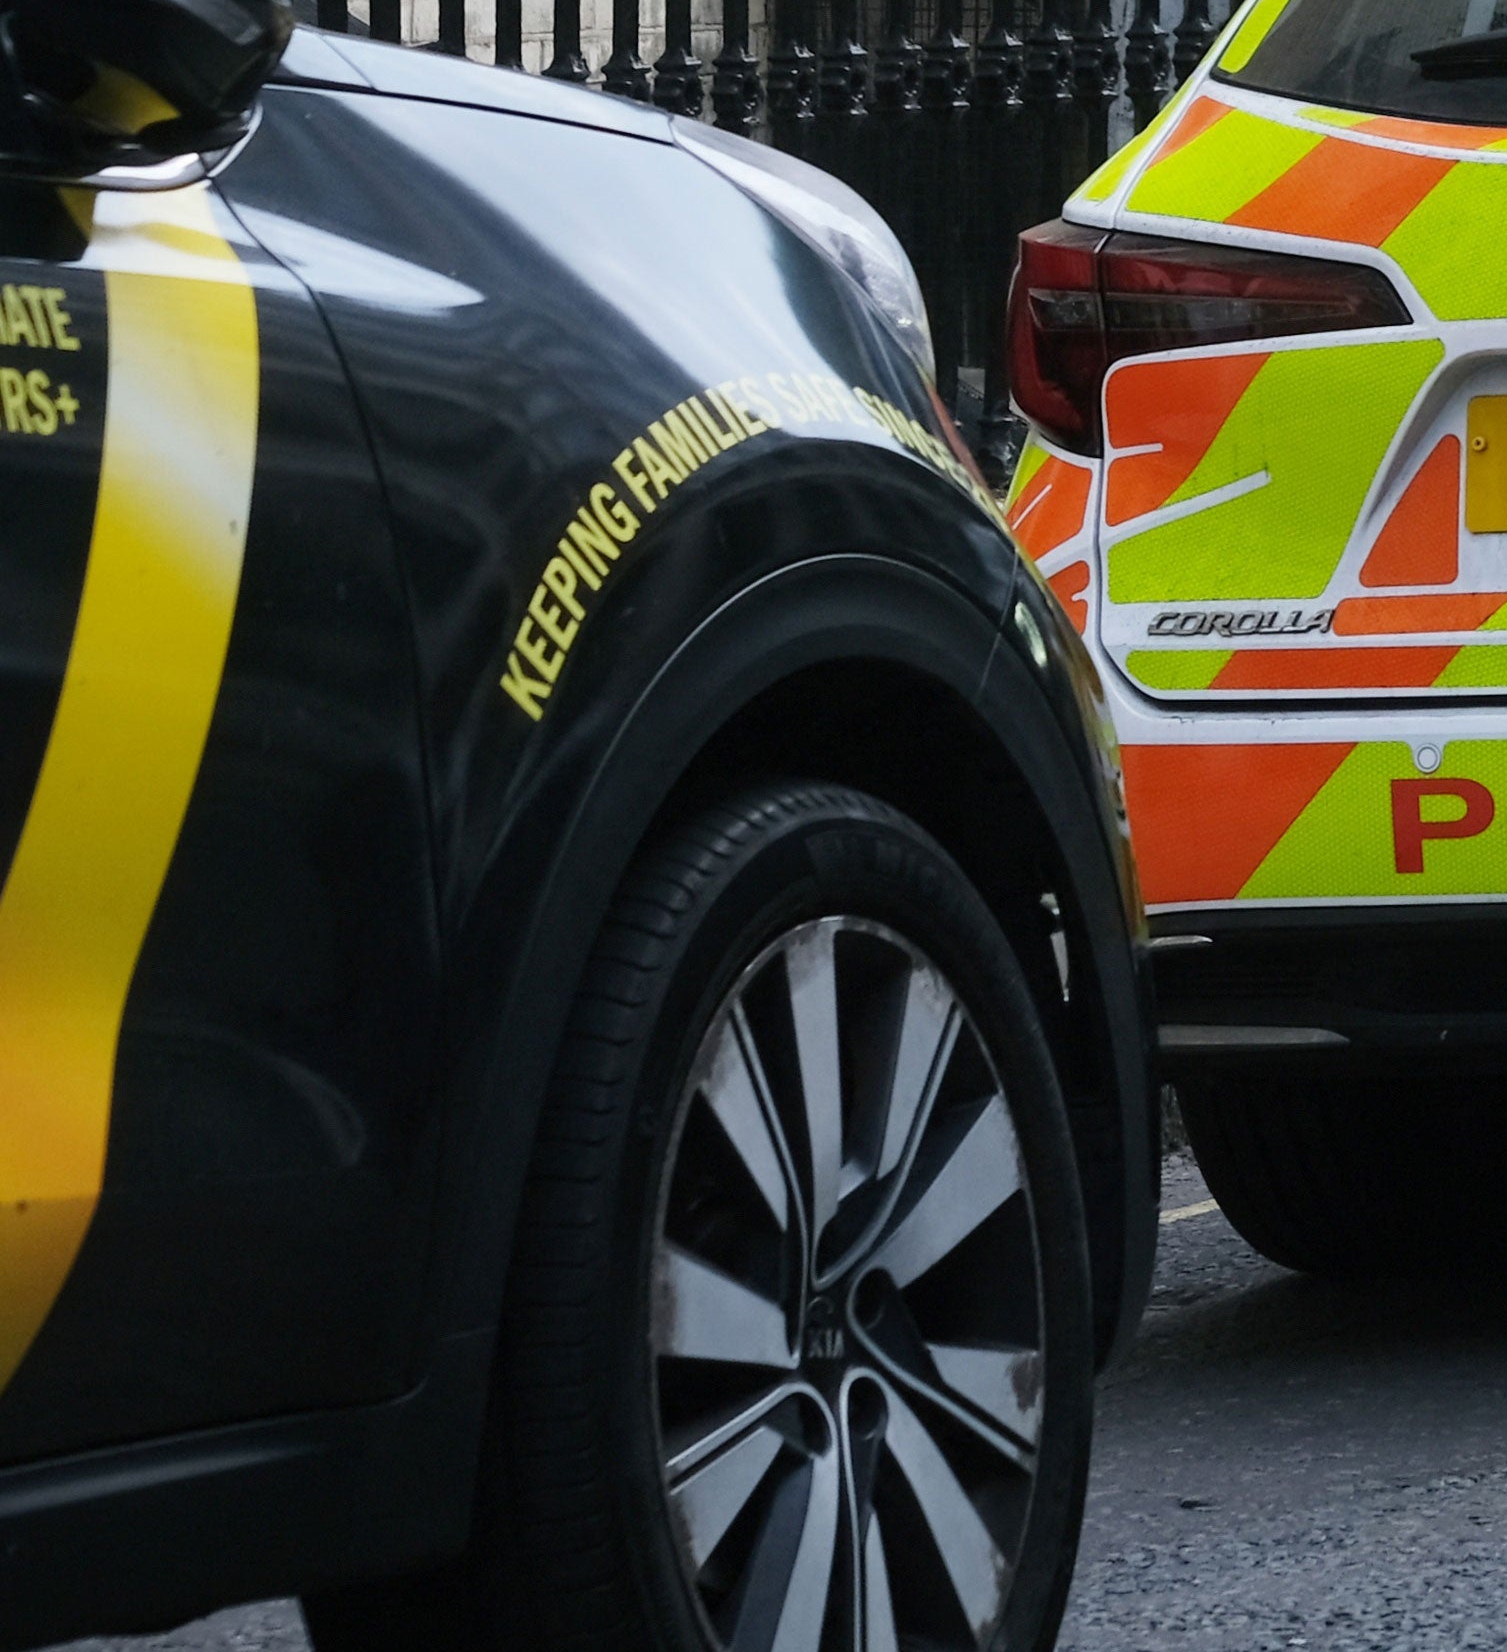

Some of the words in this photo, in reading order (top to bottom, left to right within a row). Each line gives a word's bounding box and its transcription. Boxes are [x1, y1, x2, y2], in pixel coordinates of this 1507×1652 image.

[0, 283, 82, 352] ATE
[0, 367, 81, 436] RS+
[501, 482, 641, 722] KEEPING
[612, 376, 782, 514] FAMILIES
[768, 372, 871, 428] SAFE
[1147, 608, 1335, 638] COROLLA
